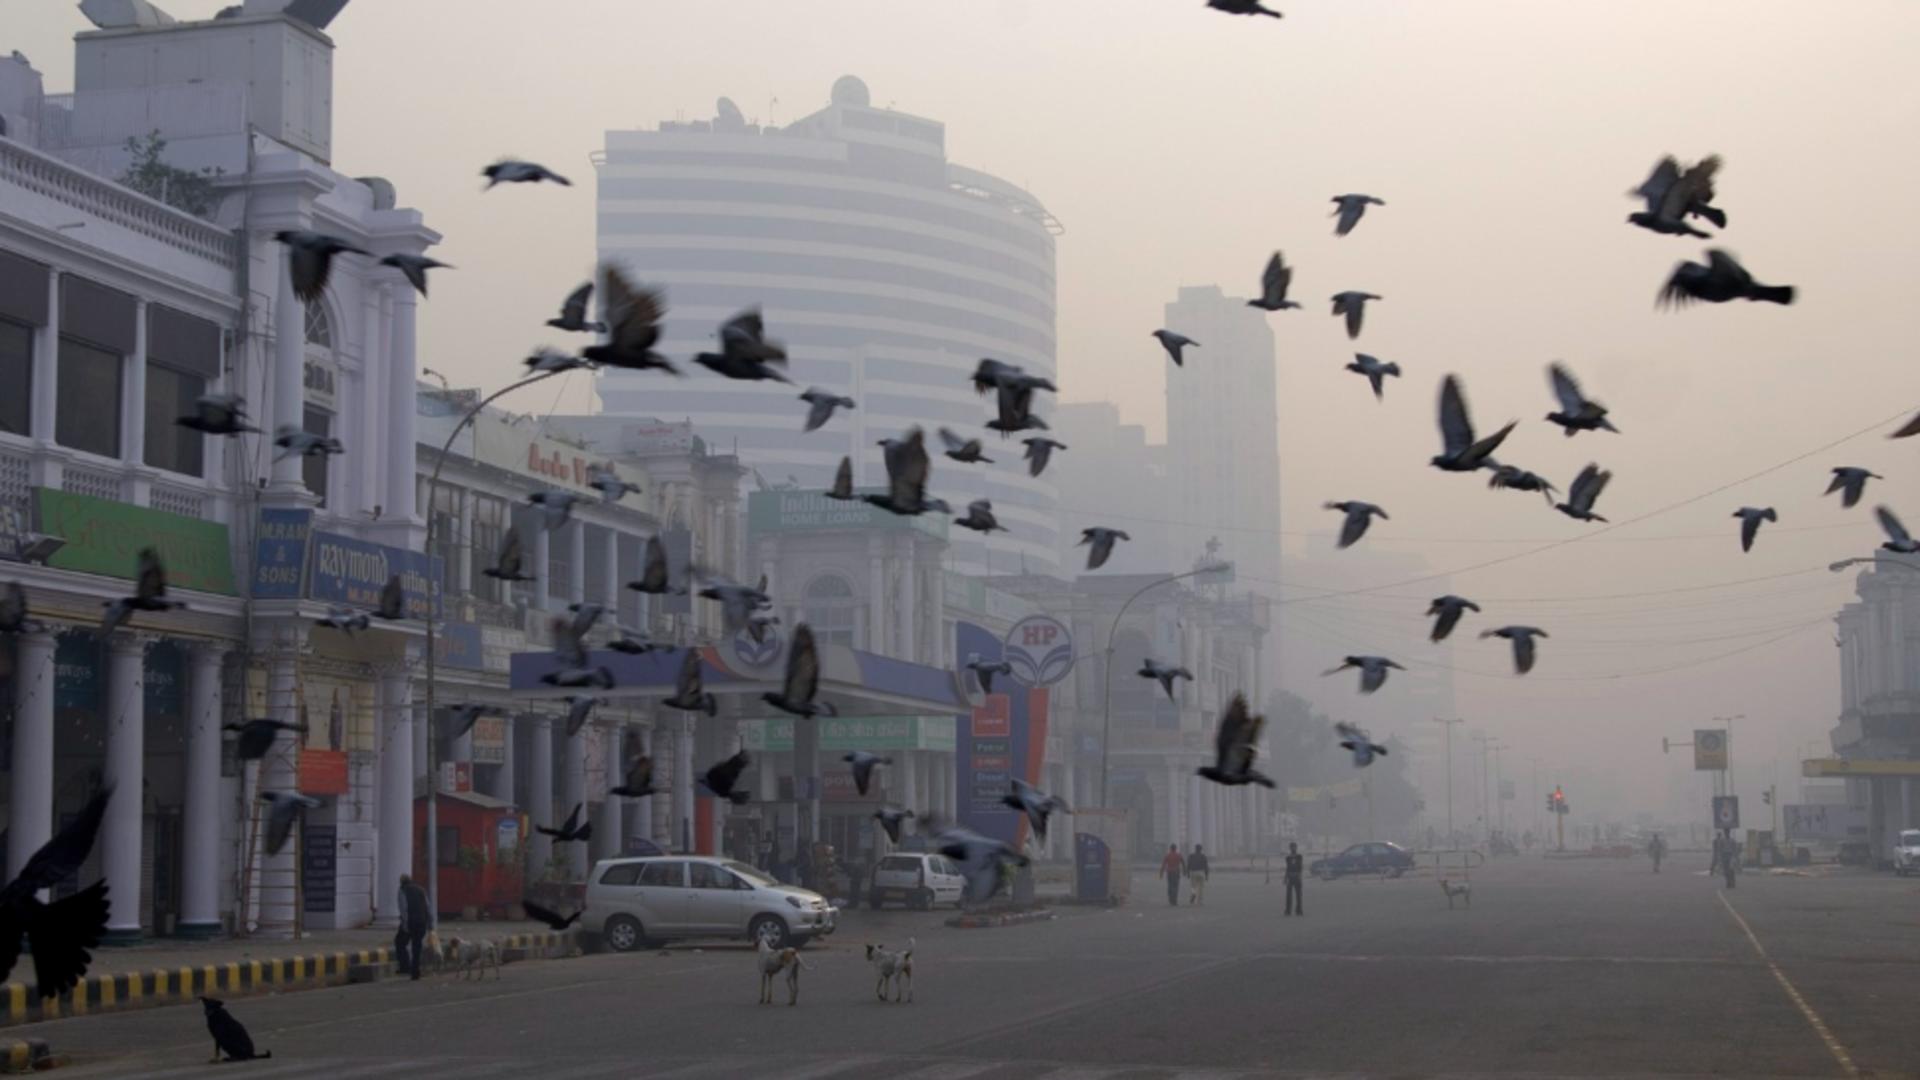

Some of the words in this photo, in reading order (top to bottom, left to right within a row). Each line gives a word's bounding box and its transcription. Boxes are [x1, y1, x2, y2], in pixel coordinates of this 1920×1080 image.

[826, 511, 872, 524] LOANS
[258, 564, 299, 584] SONS
[319, 544, 389, 590] Raymond
[1021, 625, 1058, 645] HP
